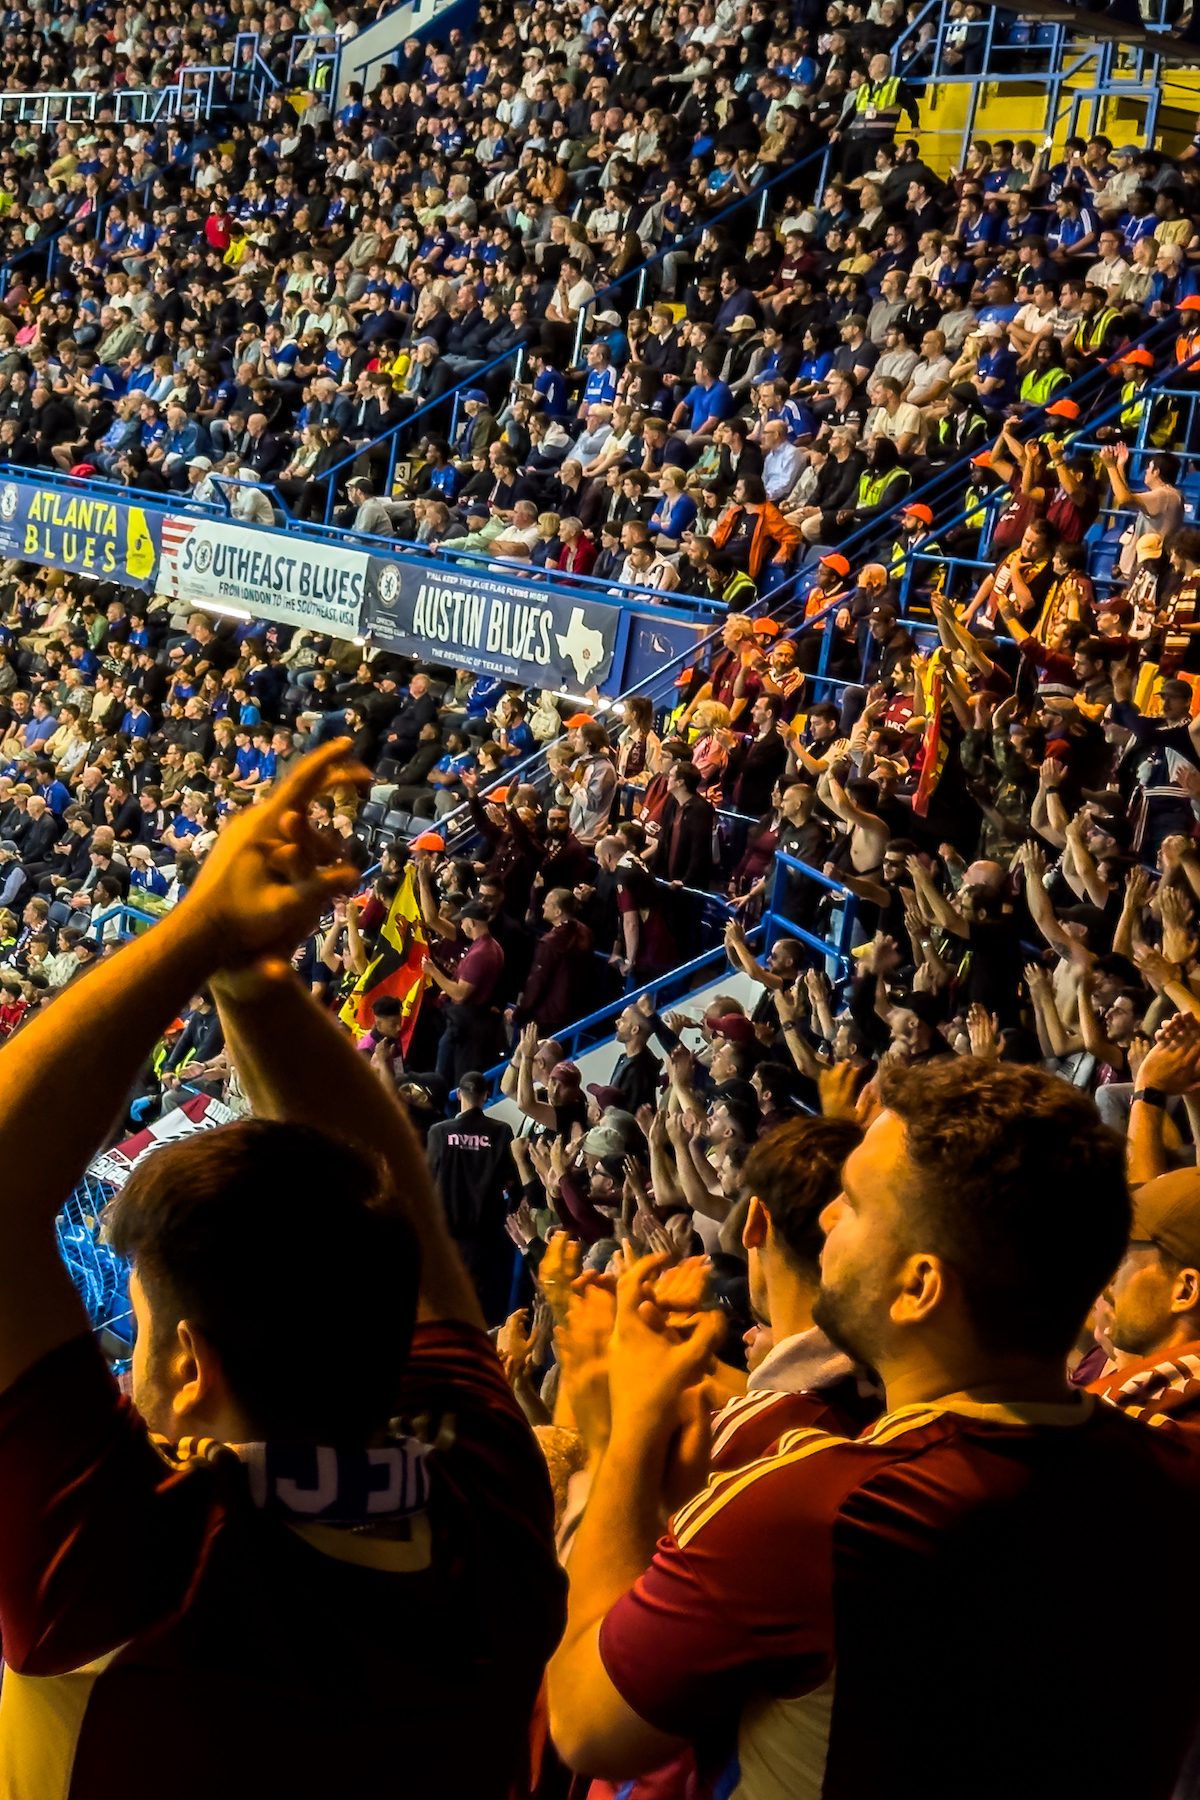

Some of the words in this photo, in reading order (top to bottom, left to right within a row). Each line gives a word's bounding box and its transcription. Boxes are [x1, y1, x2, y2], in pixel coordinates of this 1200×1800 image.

[399, 466, 406, 478] 3
[27, 490, 118, 538] ATLANTA
[23, 524, 117, 573] BLUES
[218, 581, 240, 597] FROM
[241, 586, 272, 604] LONDON
[272, 593, 282, 607] TO
[283, 596, 296, 611] THE
[339, 609, 355, 626] USA
[299, 562, 364, 609] BLUES
[442, 574, 458, 585] KEEP
[460, 577, 471, 588] THE
[472, 580, 489, 591] BLUE
[489, 583, 506, 594] FLAG
[506, 586, 528, 599] FLYING
[412, 584, 486, 648] AUSTIN
[486, 600, 553, 665] BLUES
[431, 648, 443, 658] THE
[444, 651, 473, 665] REPUBLIC
[473, 657, 482, 667] OF
[482, 660, 503, 673] TEXAS
